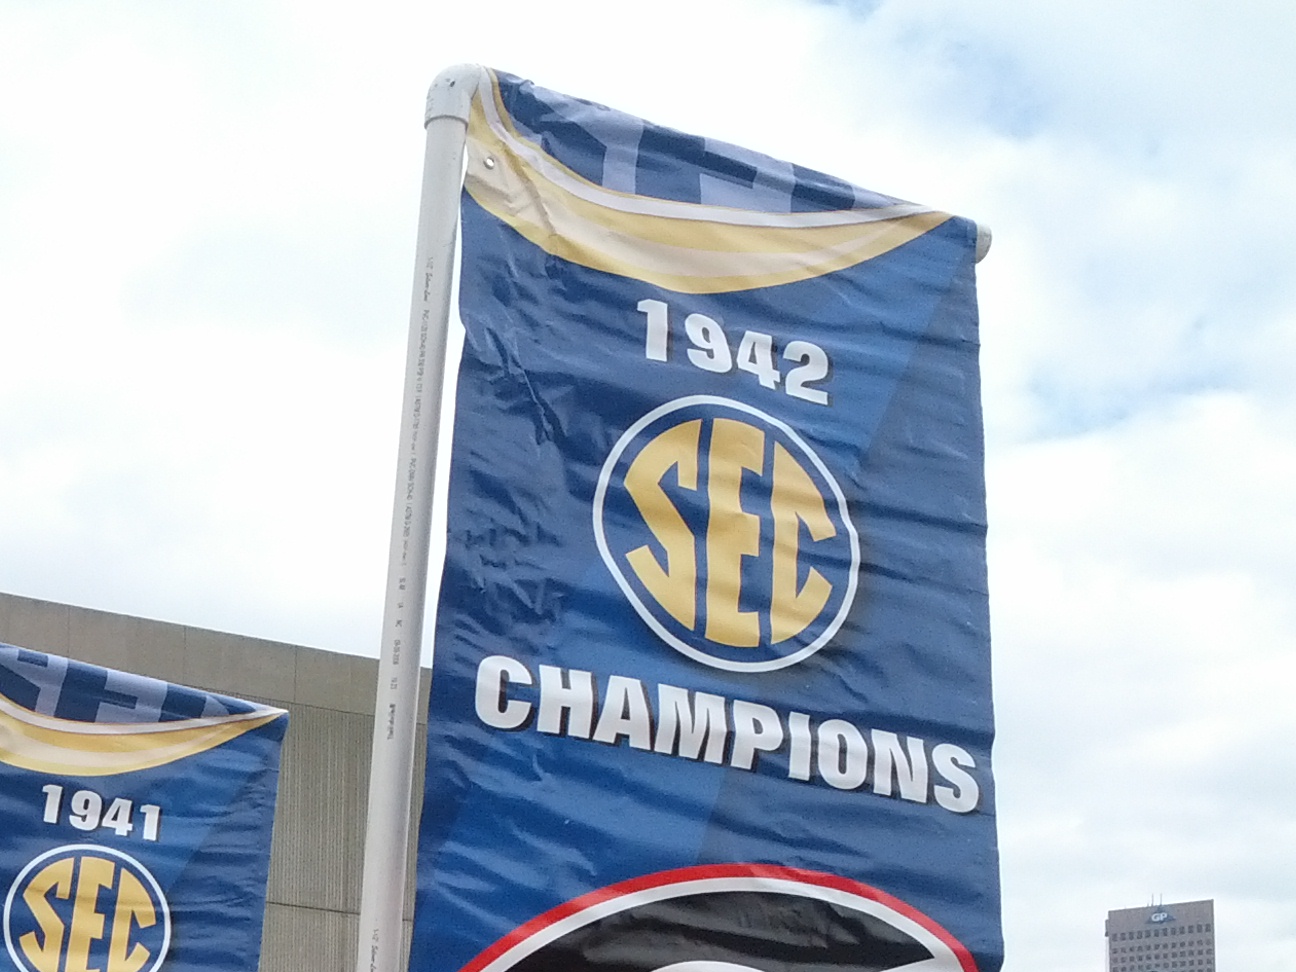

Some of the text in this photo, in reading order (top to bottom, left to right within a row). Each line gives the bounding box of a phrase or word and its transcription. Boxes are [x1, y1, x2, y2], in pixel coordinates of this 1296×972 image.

[637, 299, 833, 407] 1942
[623, 417, 837, 648] SEC
[474, 654, 980, 814] CHAMPIONS
[42, 783, 162, 842] 1941
[1151, 911, 1168, 923] GP
